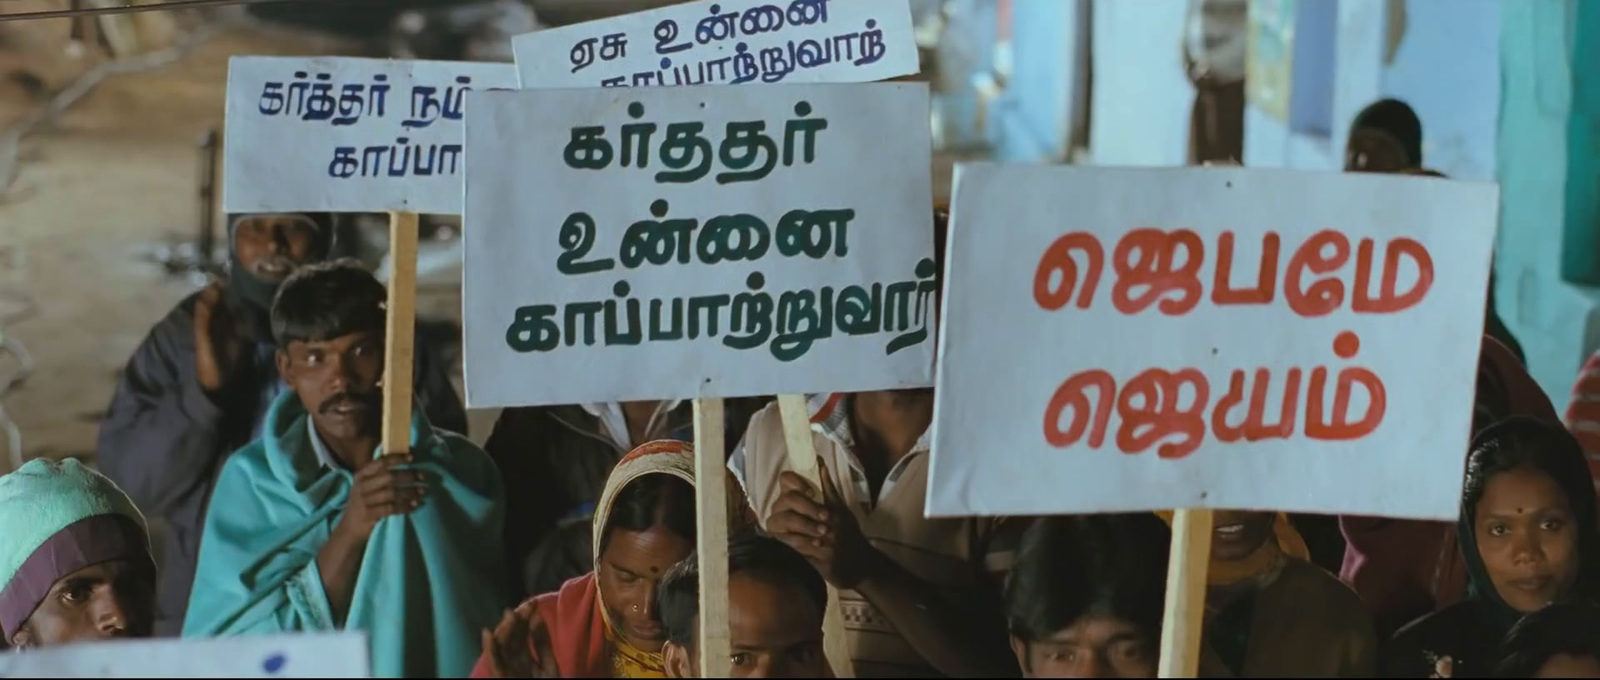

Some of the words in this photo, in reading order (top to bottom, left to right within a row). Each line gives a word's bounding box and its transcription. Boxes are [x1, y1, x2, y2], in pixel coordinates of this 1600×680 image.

[570, 32, 628, 74] ஏசு
[654, 0, 828, 55] உன்னை
[259, 71, 391, 126] கர்த்தர்
[328, 137, 463, 179] காப்பா
[563, 101, 828, 185] கர்ததர்
[556, 198, 856, 275] உன்னை
[1033, 228, 1435, 317] ஜெபமே
[505, 257, 936, 362] காப்பாற்றுவார்
[1043, 330, 1387, 459] ஜெயம்
